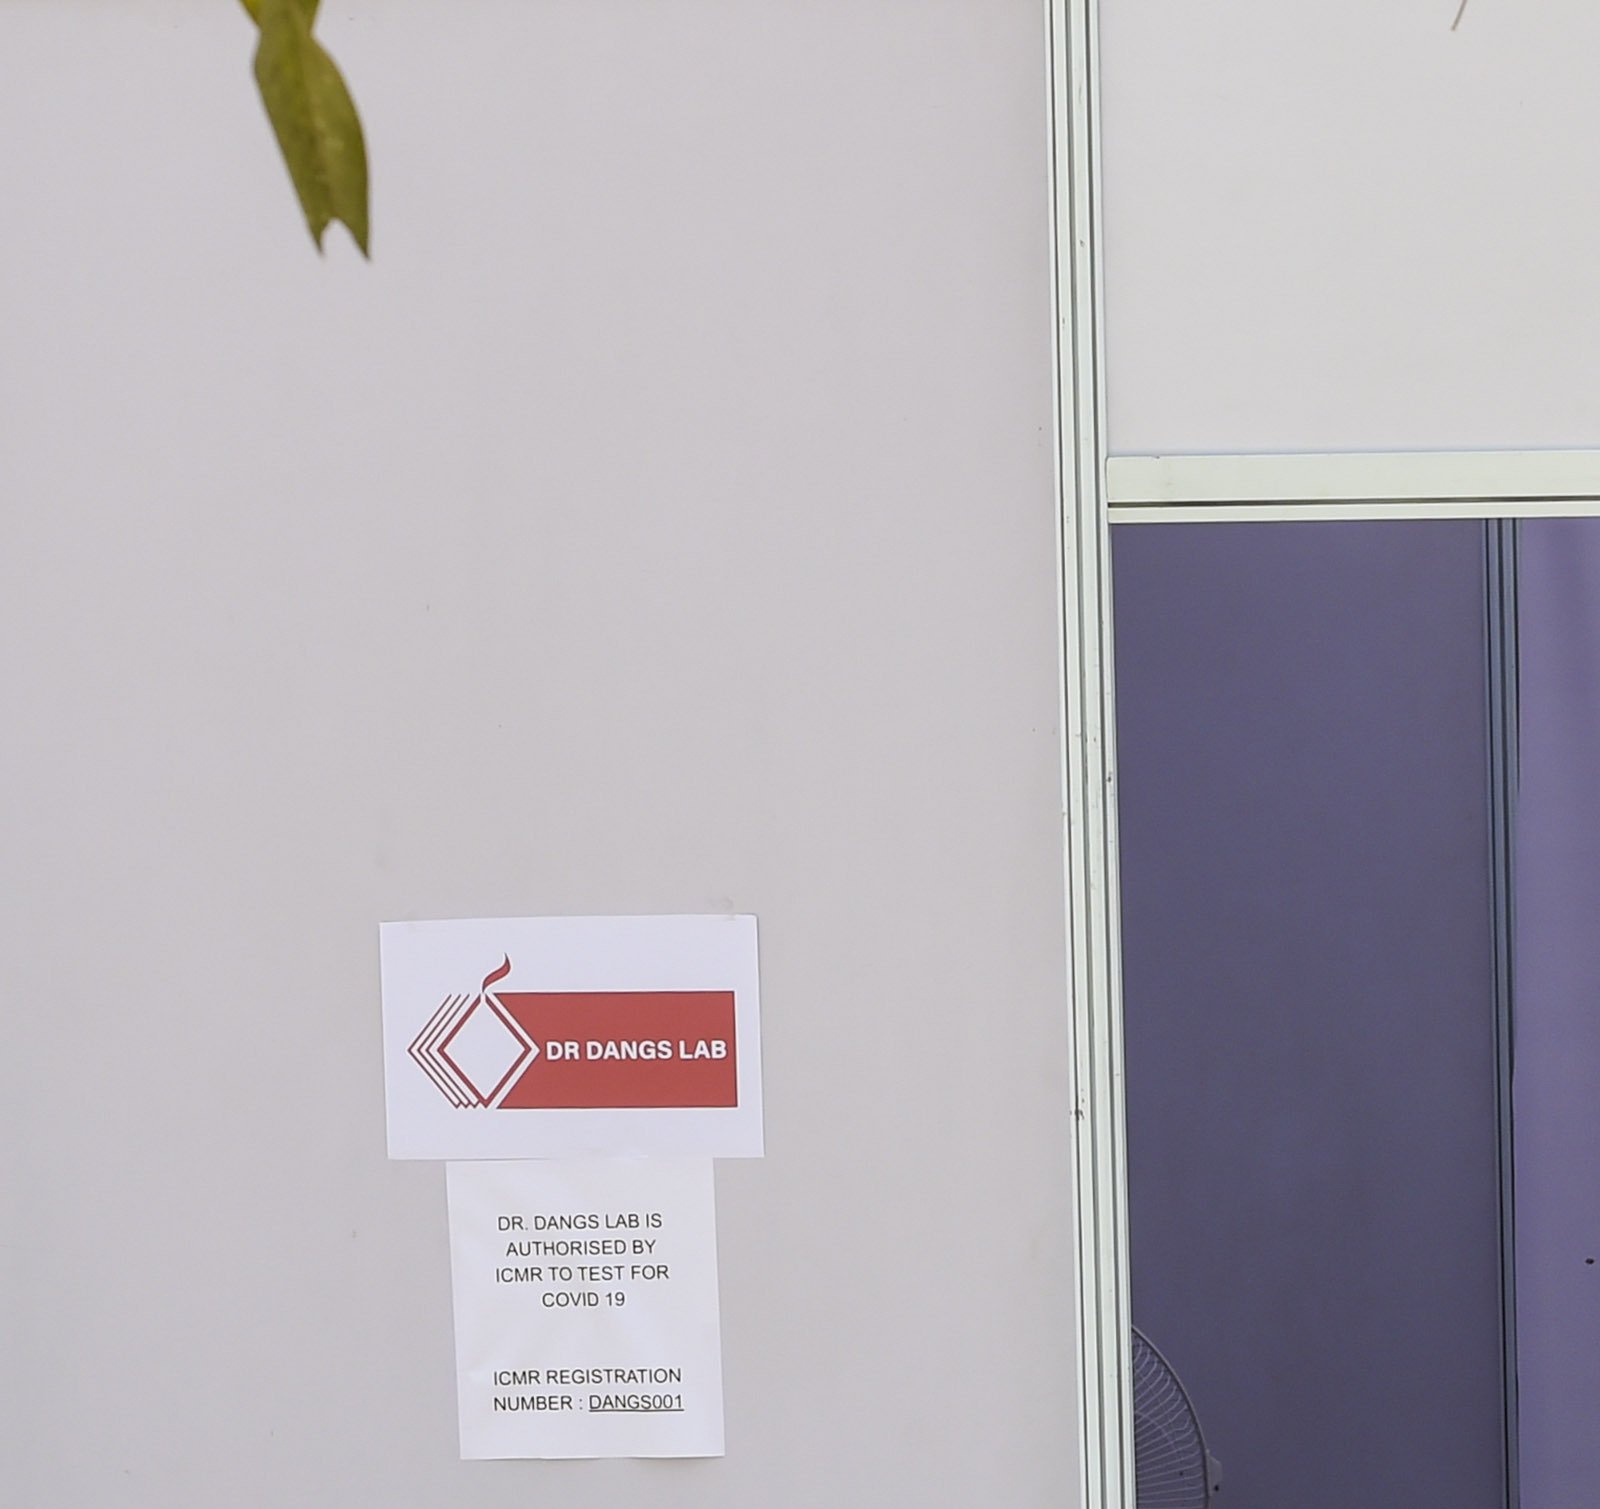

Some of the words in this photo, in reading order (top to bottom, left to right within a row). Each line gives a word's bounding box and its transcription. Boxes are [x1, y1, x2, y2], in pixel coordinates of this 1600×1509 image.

[547, 1041, 579, 1060] DR
[586, 1040, 672, 1060] DANGS
[679, 1040, 727, 1059] LAB
[498, 1216, 528, 1231] DR.
[534, 1214, 599, 1230] DANGS
[605, 1214, 640, 1229] LAB
[646, 1213, 662, 1228] IS
[506, 1239, 626, 1257] AUTHORISED
[632, 1239, 656, 1254] BY
[496, 1267, 543, 1283] ICMR
[548, 1266, 572, 1281] TO
[577, 1265, 625, 1281] TEST
[631, 1265, 669, 1280] FOR
[542, 1292, 599, 1307] COVID
[605, 1292, 625, 1306] 19
[494, 1370, 541, 1386] ICMR
[546, 1368, 681, 1384] REGISTRATION
[494, 1395, 573, 1411] NUMBER
[579, 1398, 583, 1410] :
[588, 1394, 685, 1413] DANGS001
